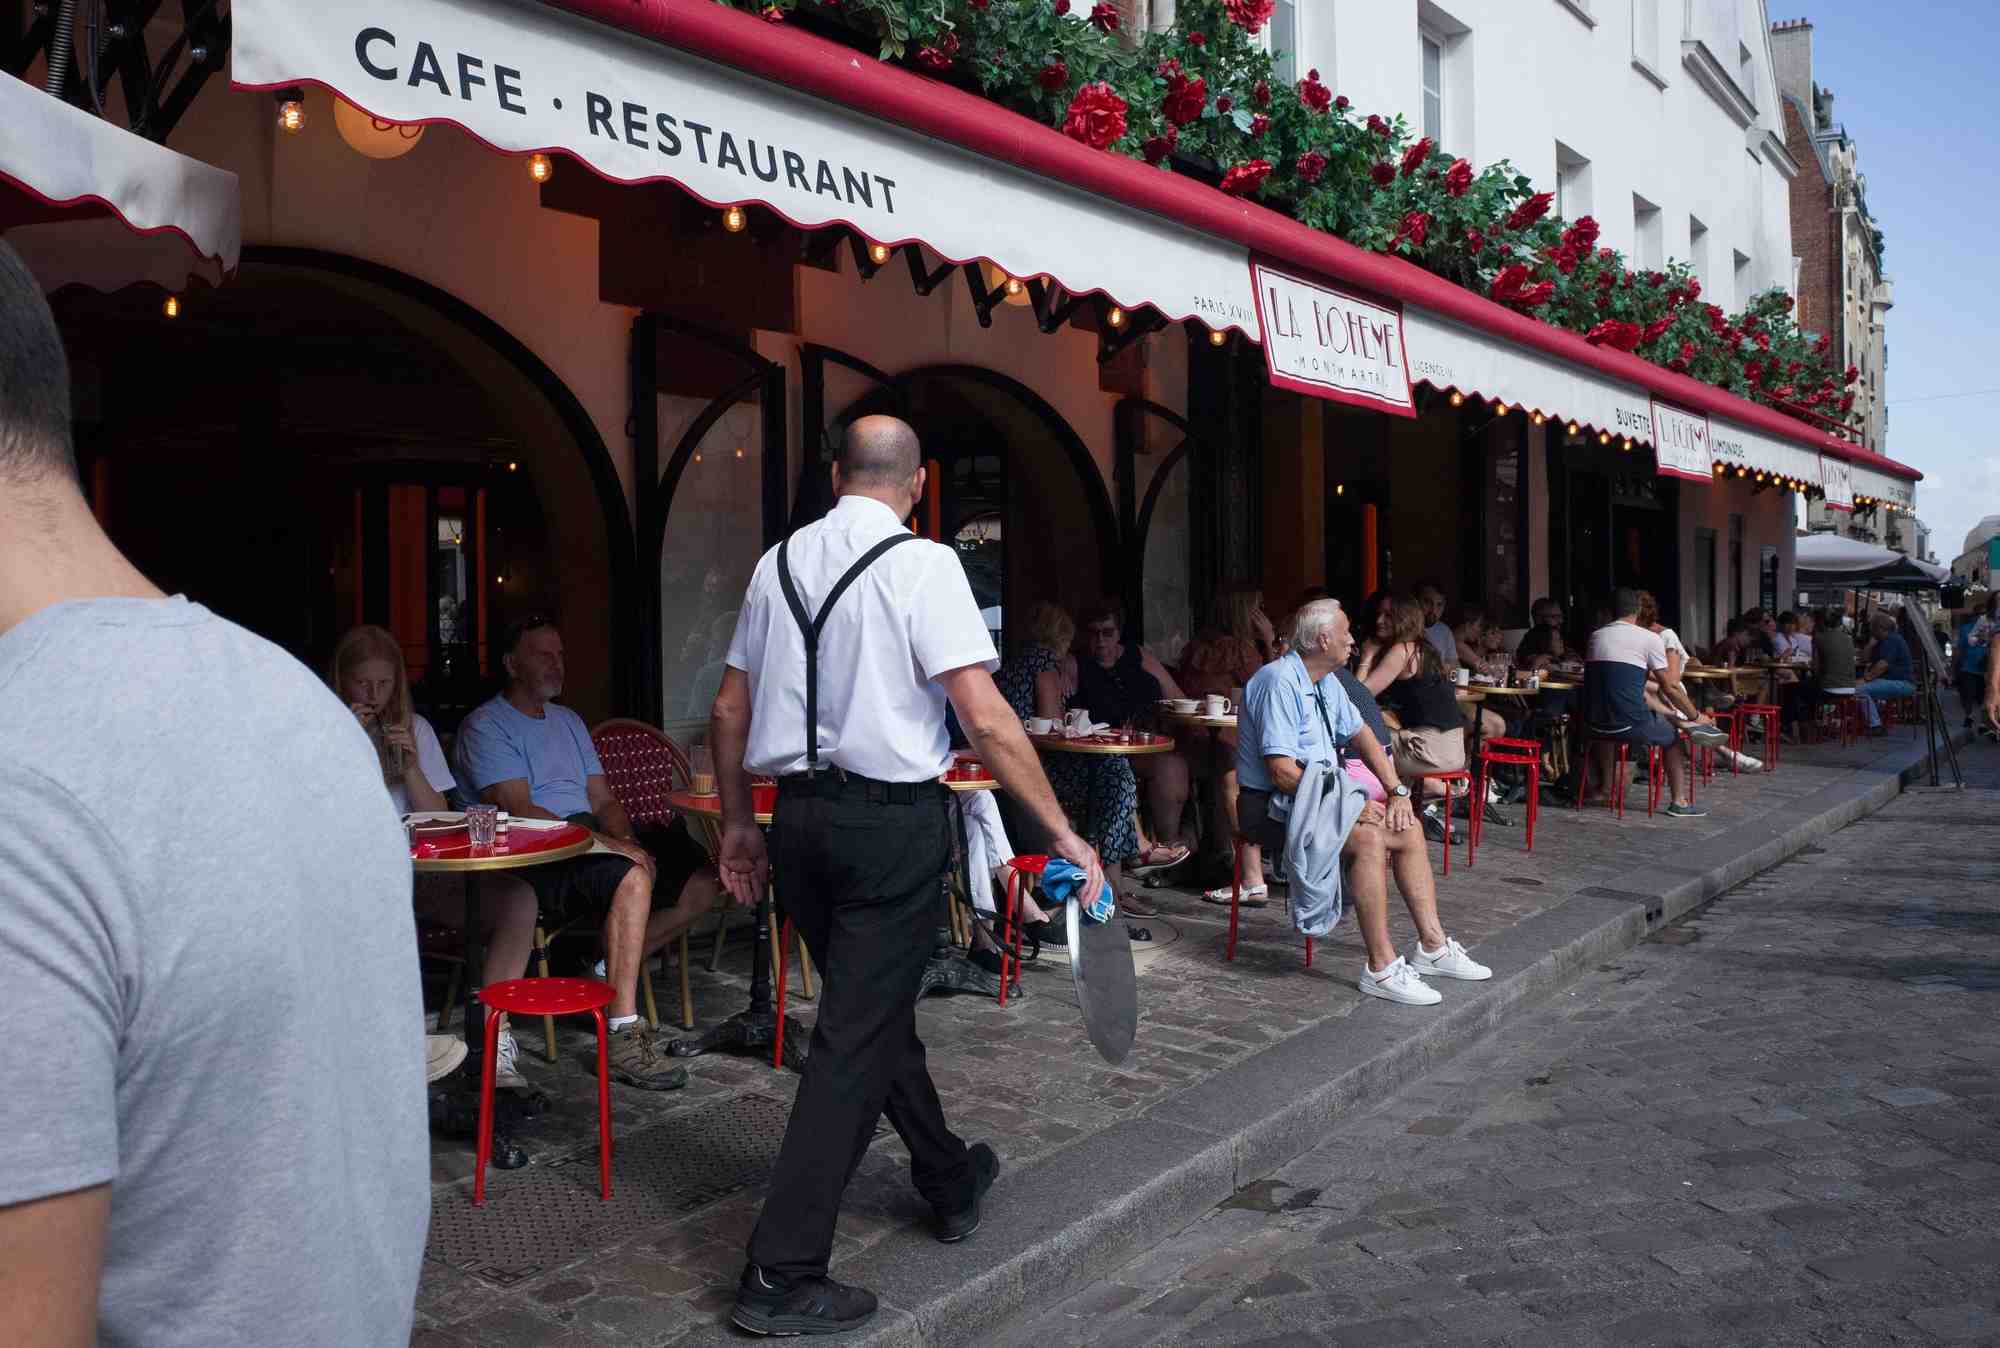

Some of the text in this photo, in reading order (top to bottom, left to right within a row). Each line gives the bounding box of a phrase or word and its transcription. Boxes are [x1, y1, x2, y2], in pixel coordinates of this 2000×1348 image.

[354, 26, 896, 214] CAFE RESTAURANT
[1193, 295, 1226, 316] PARIS
[1268, 287, 1302, 338] LA
